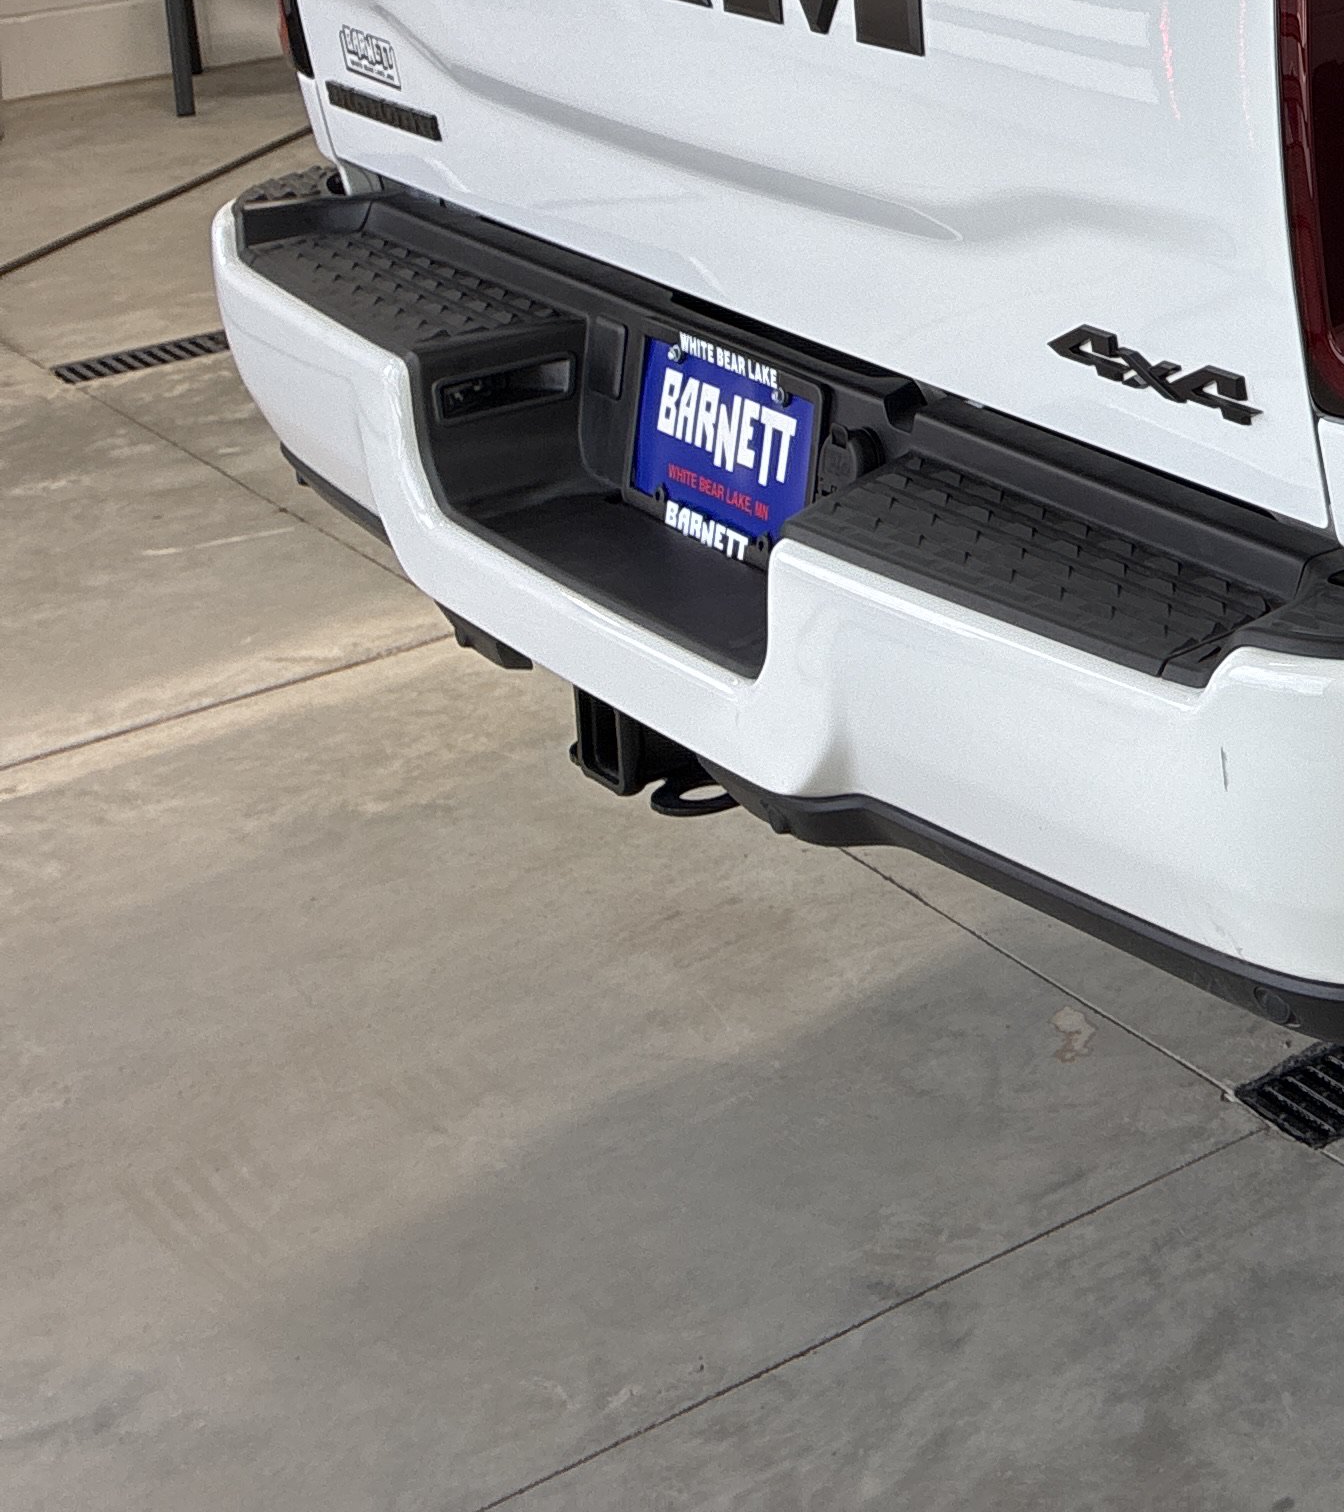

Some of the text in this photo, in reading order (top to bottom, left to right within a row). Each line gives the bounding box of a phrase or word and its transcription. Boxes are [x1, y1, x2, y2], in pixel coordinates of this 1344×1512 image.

[679, 331, 778, 388] WHITE BEAR LAKE
[657, 367, 797, 486] BARNETT
[667, 463, 697, 488] WHITE
[698, 475, 725, 500] BEAR
[755, 501, 769, 521] MN
[664, 500, 749, 561] BARNETT
